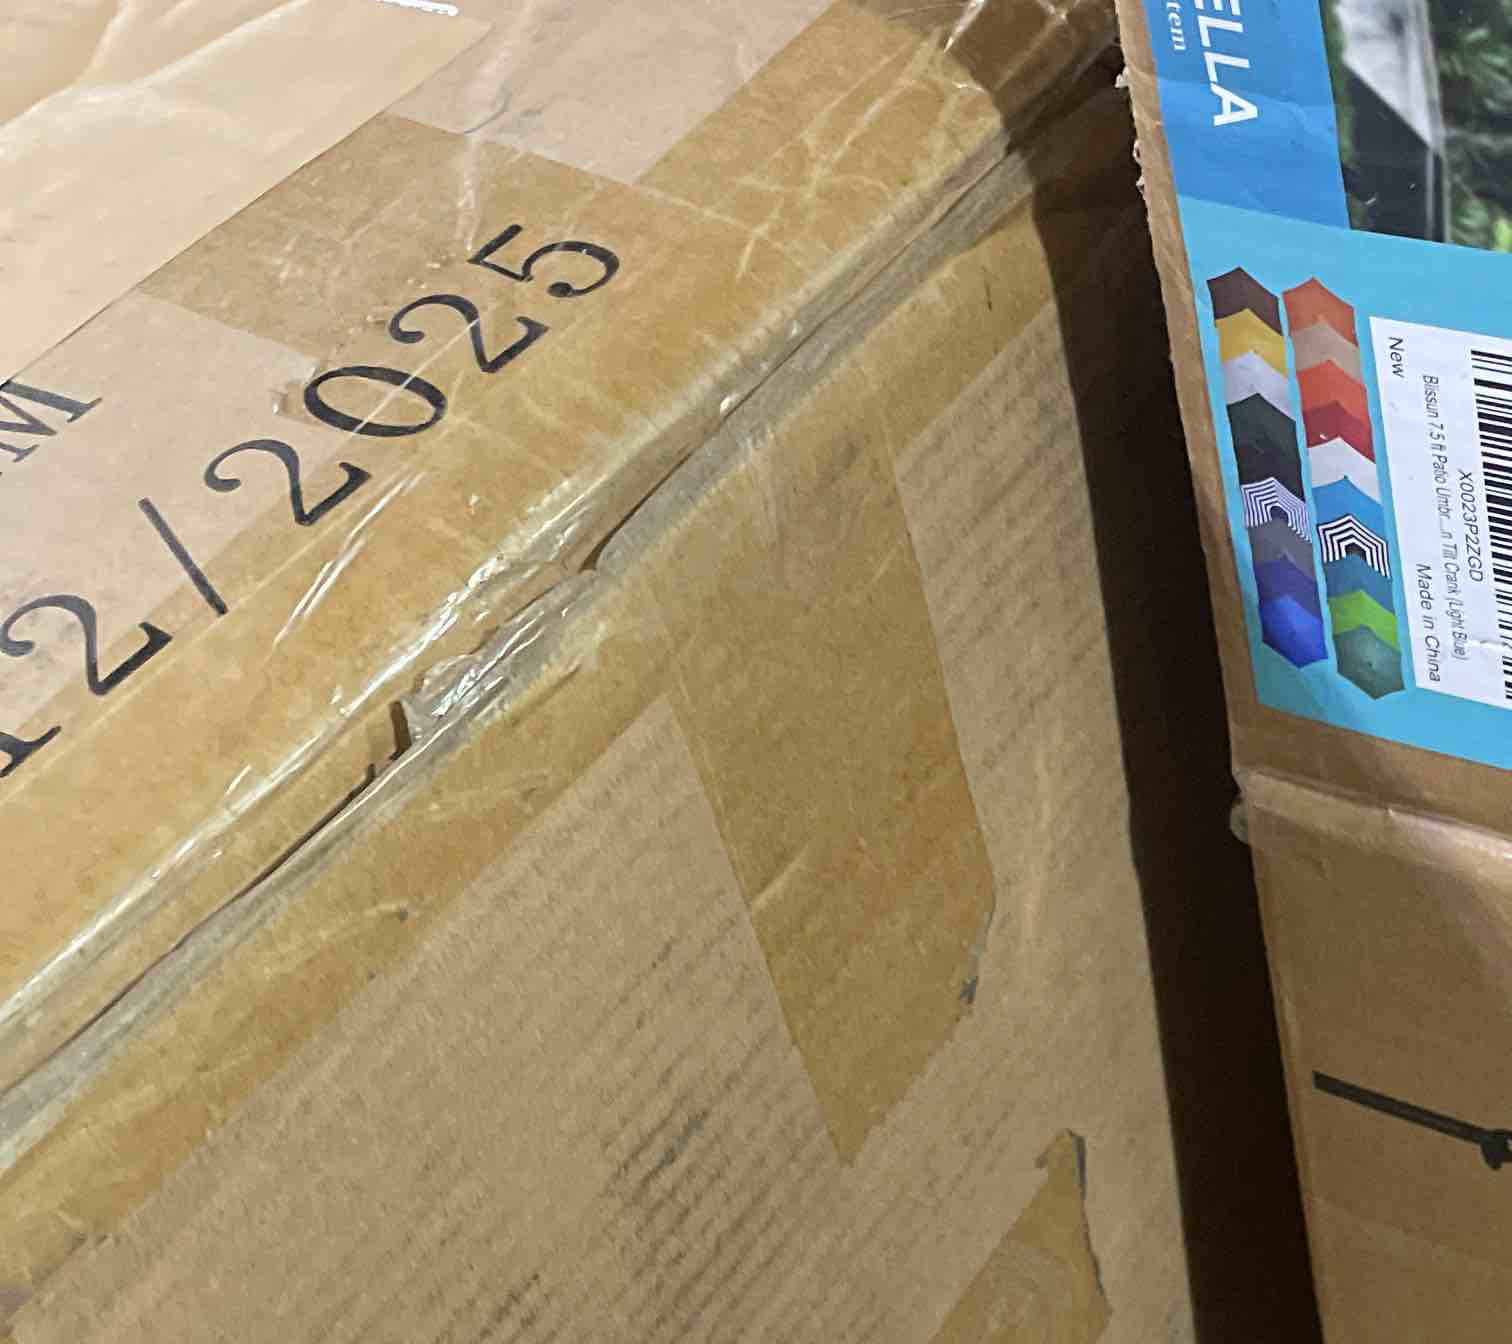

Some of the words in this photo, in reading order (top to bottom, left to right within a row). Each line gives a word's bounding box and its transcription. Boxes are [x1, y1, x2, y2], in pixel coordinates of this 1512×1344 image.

[1389, 337, 1404, 378] New
[1422, 374, 1439, 419] Blissun
[1433, 454, 1447, 485] Patio
[1442, 542, 1458, 560] Tilt
[1415, 563, 1433, 612] Made
[1442, 561, 1460, 595] Crank
[1421, 614, 1434, 636] in
[1424, 635, 1441, 683] China
